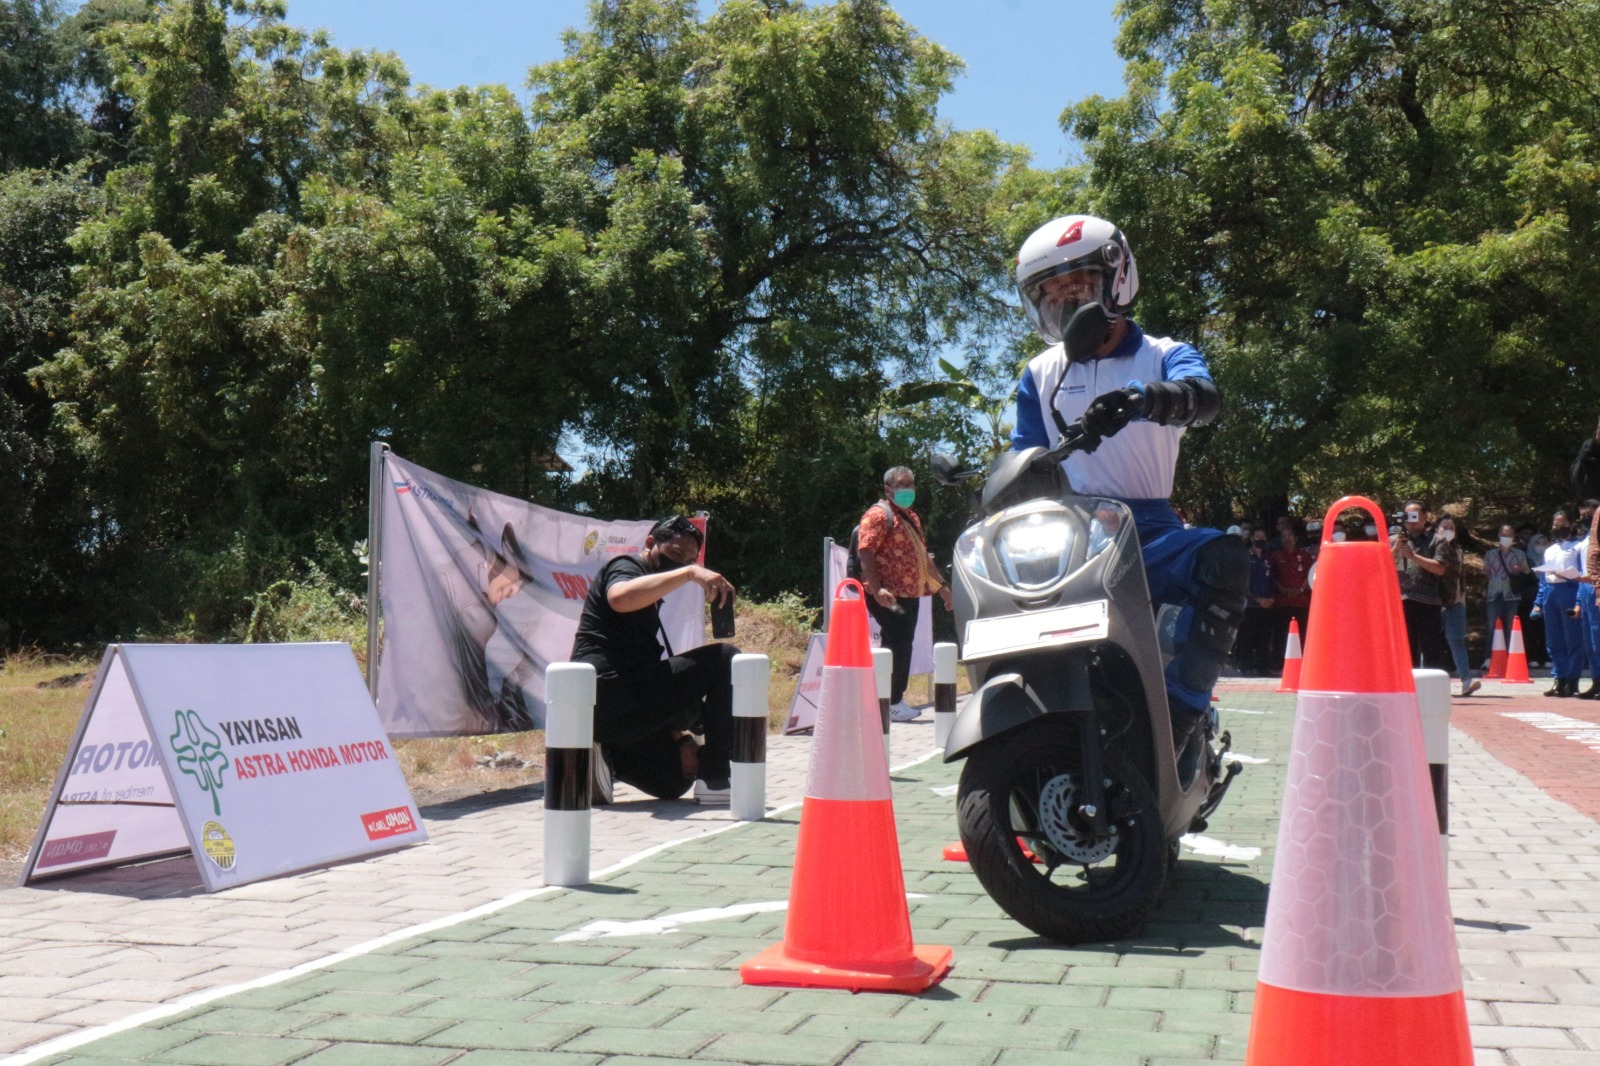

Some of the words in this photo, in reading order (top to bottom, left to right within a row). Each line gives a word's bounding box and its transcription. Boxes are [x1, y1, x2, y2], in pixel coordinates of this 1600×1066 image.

[219, 716, 302, 746] YAYASAN
[234, 753, 288, 780] ASTRA
[287, 747, 341, 772] HONDA
[338, 740, 389, 765] MOTOR
